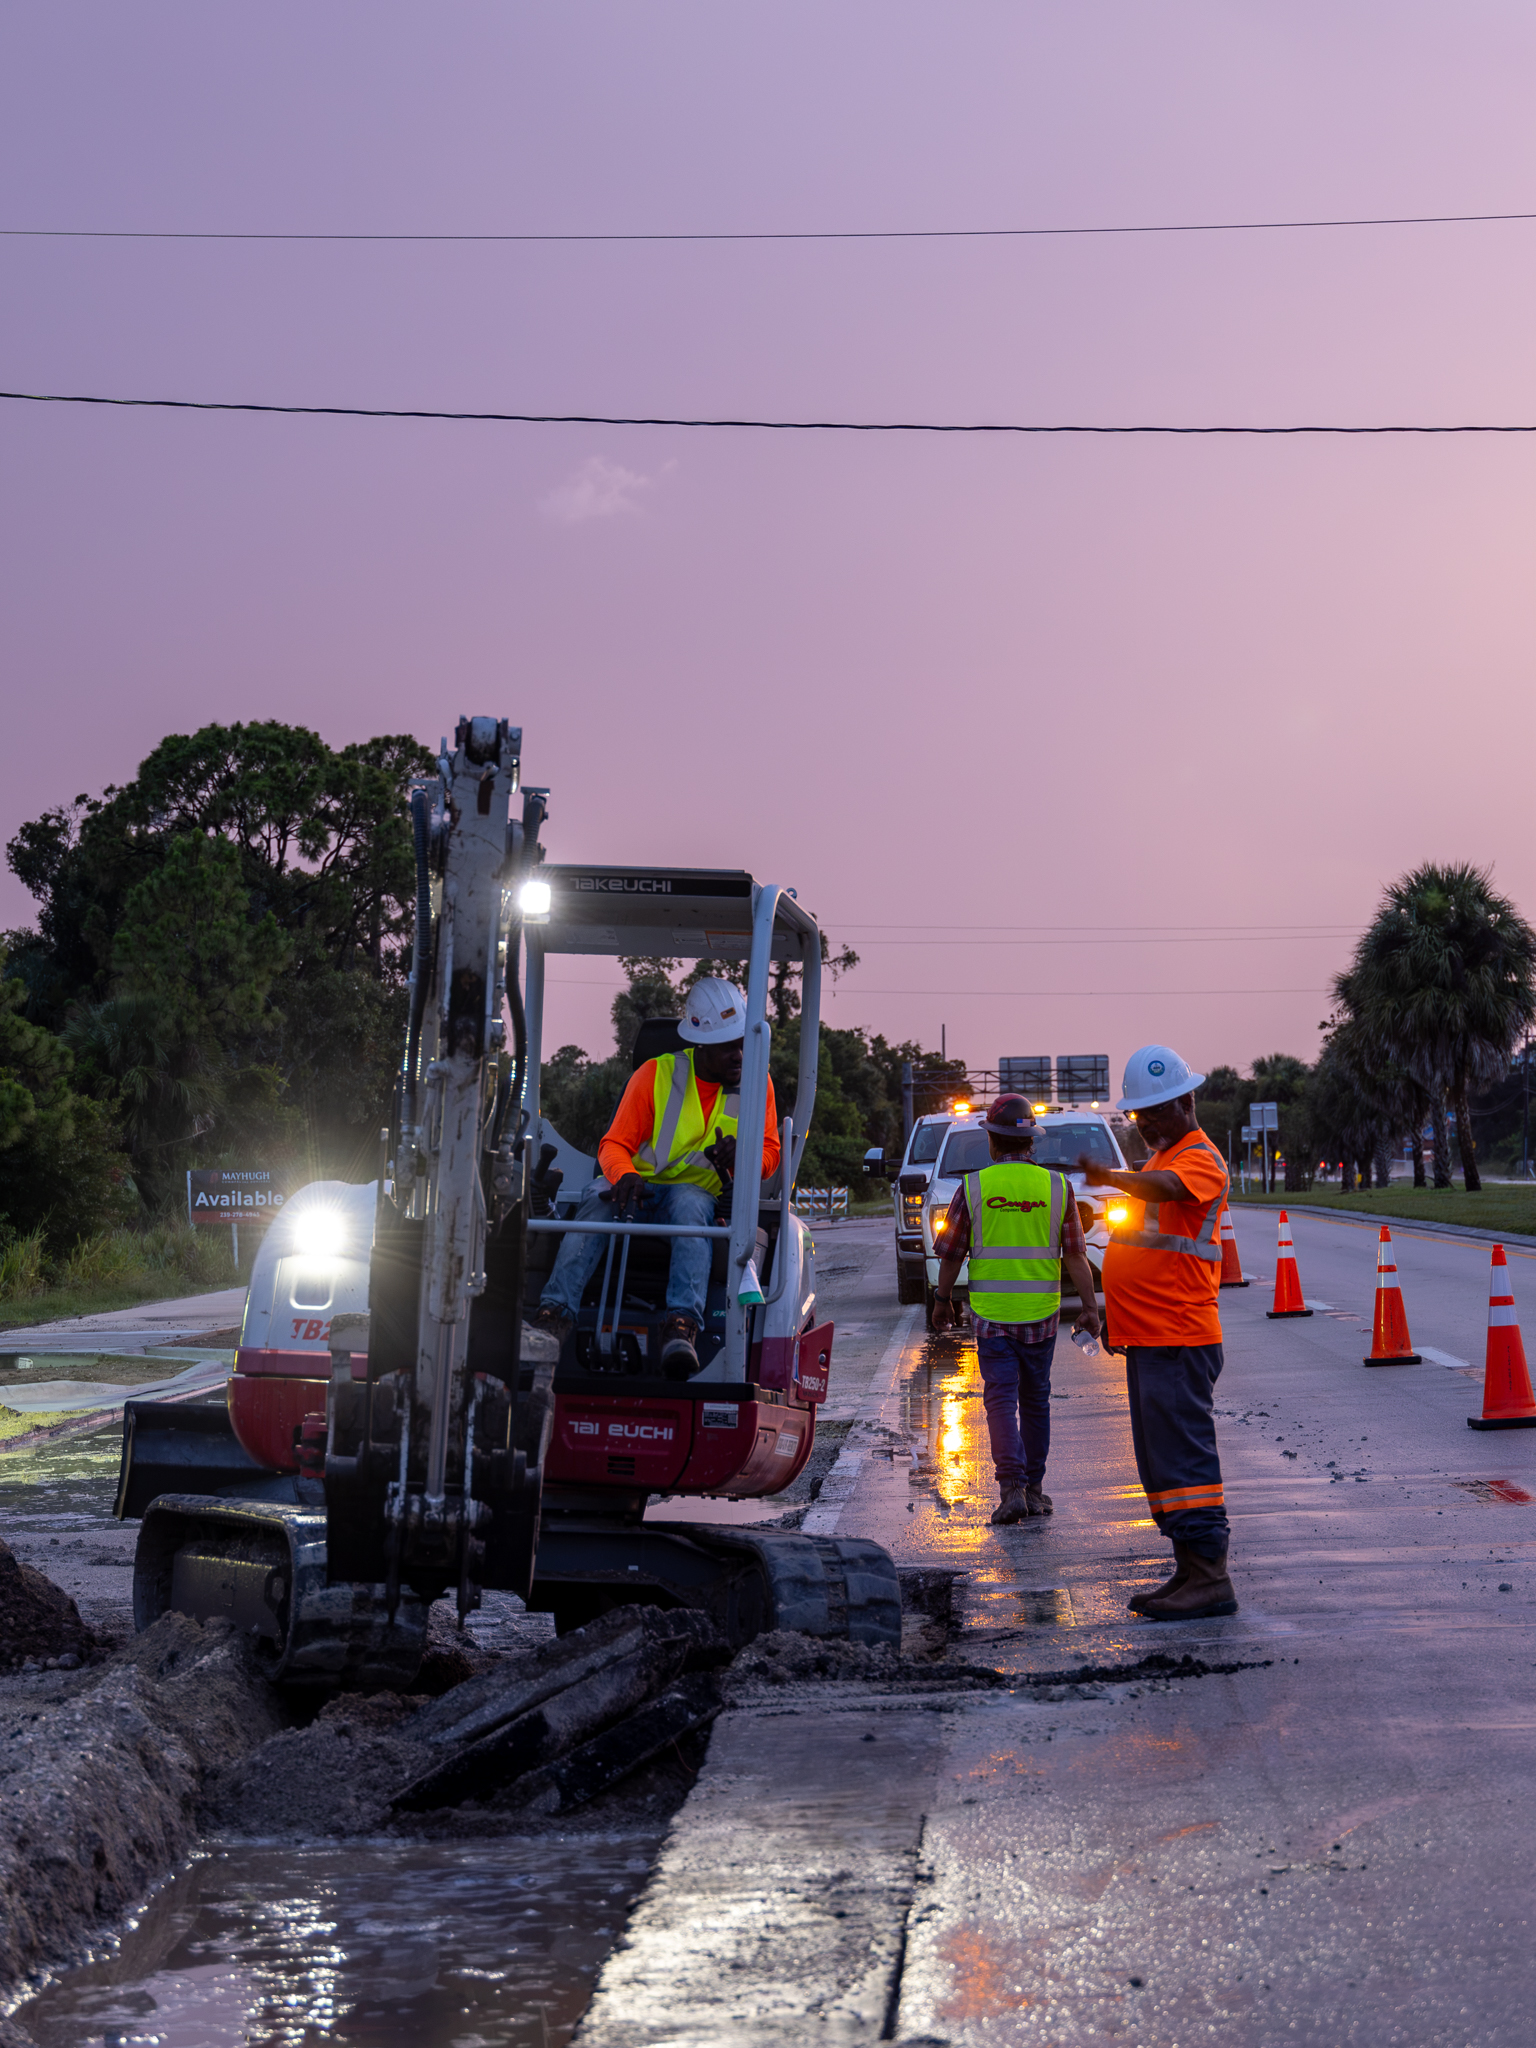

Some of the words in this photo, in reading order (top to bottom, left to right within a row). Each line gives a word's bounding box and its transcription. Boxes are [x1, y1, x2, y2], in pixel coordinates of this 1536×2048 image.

[222, 1171, 270, 1180] MAYHUGH
[195, 1190, 284, 1206] Available
[986, 1196, 1047, 1212] Cougar
[802, 1374, 826, 1392] TB250-2
